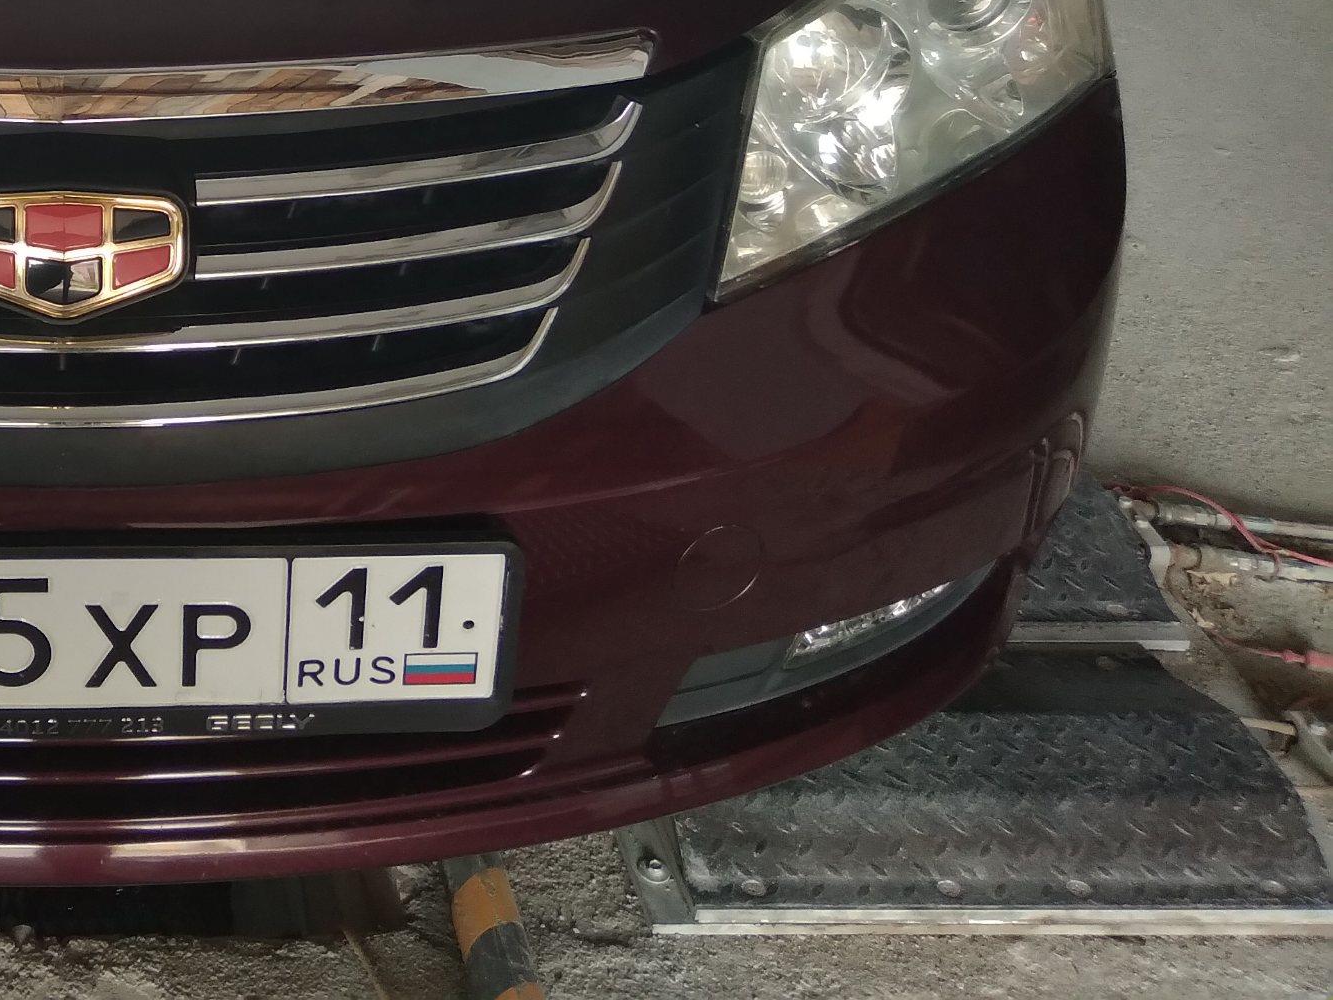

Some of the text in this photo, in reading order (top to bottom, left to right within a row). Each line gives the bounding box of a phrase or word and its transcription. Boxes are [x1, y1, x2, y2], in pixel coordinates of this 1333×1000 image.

[315, 565, 444, 650] 11
[297, 656, 396, 688] RUS
[205, 713, 316, 731] GEELY
